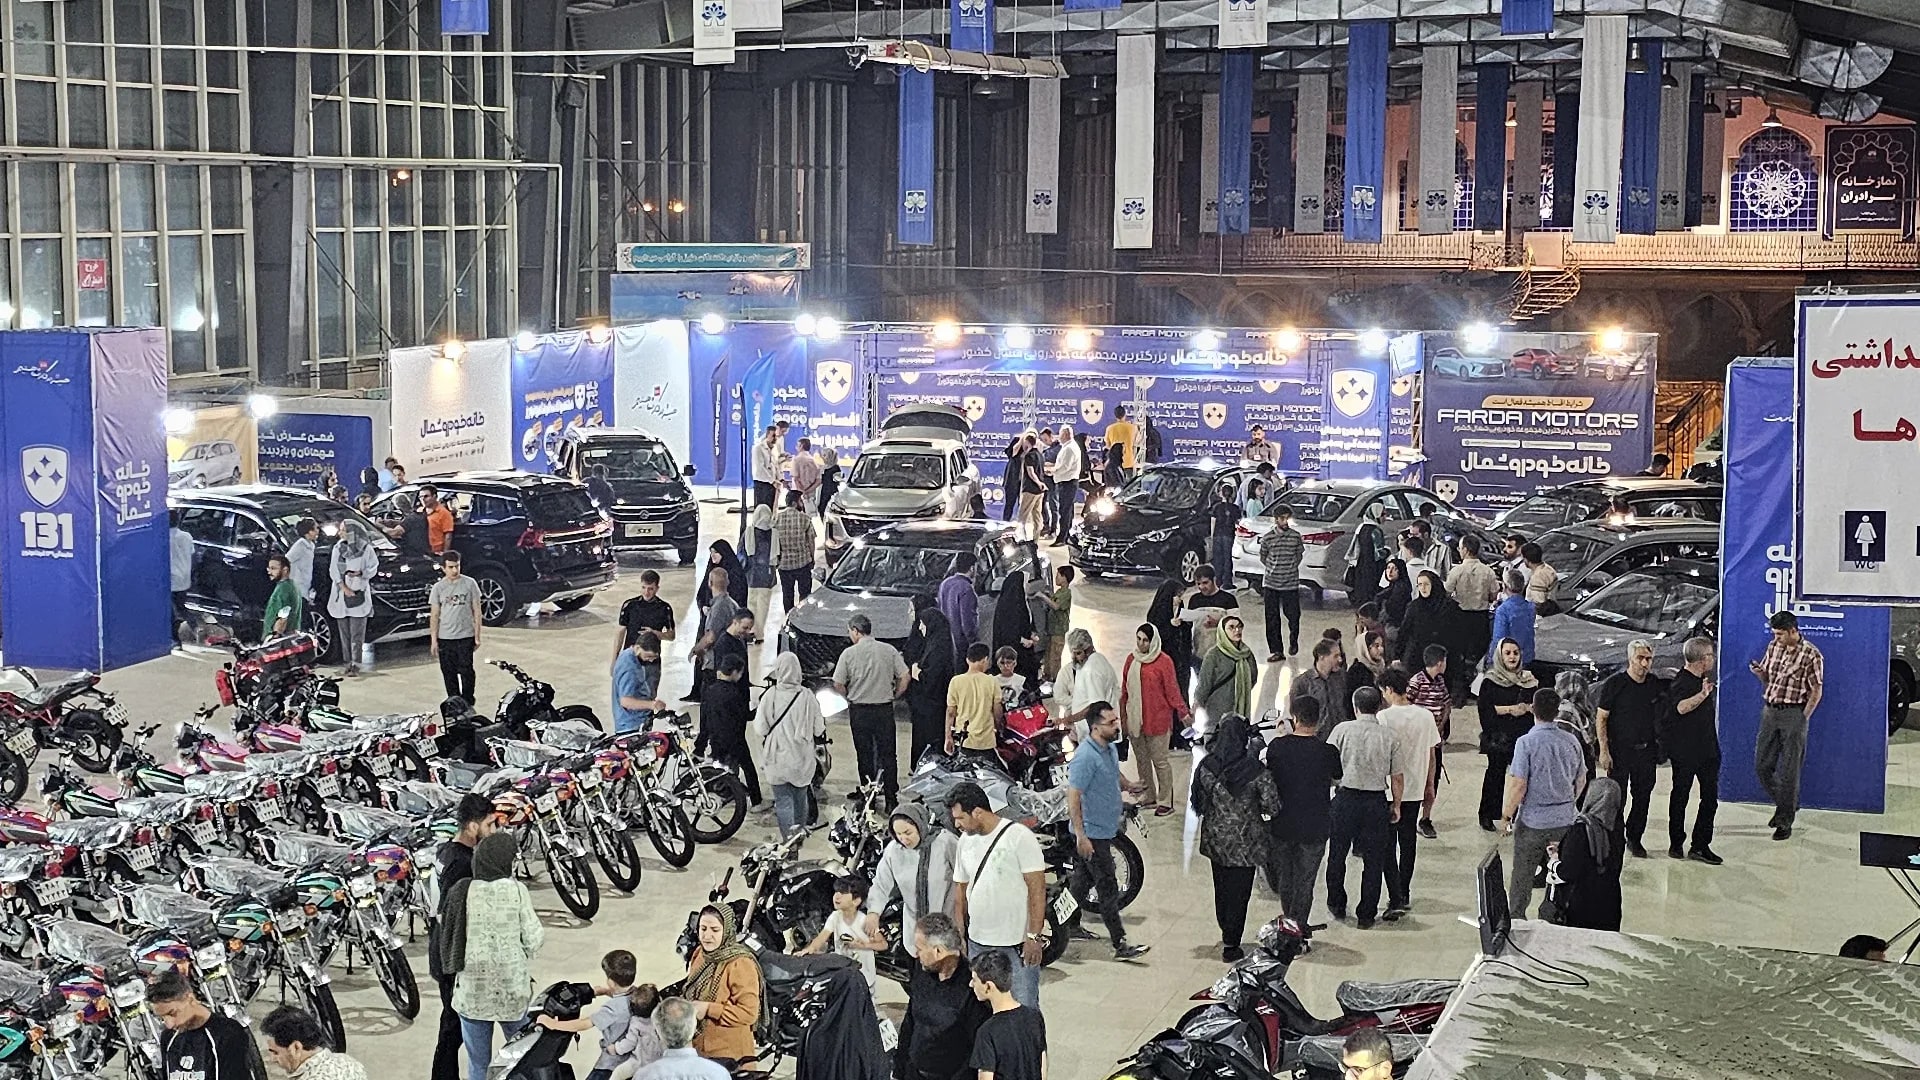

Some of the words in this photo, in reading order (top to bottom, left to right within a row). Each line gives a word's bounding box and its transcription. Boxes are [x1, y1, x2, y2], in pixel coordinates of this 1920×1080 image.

[1840, 190, 1896, 205] برادران
[961, 347, 992, 360] کشور
[1072, 350, 1118, 362] مجموعه
[1119, 350, 1168, 364] بزرگترین
[1811, 337, 1920, 379] داشتی
[1157, 402, 1199, 410] MOTORS
[1244, 404, 1281, 412] FARDA
[1567, 399, 1584, 408] شرایط
[1437, 408, 1523, 426] FARDA
[1531, 411, 1639, 430] MOTORS
[277, 430, 307, 442] عرض
[307, 432, 335, 443] ضمن
[970, 432, 1011, 441] MOTORS
[1173, 439, 1209, 447] FARDA
[1210, 440, 1247, 448] MOTOR
[297, 446, 335, 460] مهمانان
[1460, 451, 1510, 473] شمال
[1509, 455, 1567, 478] خودرو
[1566, 455, 1611, 474] خانه
[115, 460, 151, 481] خانه
[115, 479, 151, 506] خودرو
[116, 500, 152, 526] شمال
[19, 511, 74, 550] 131
[1854, 560, 1876, 571] WC
